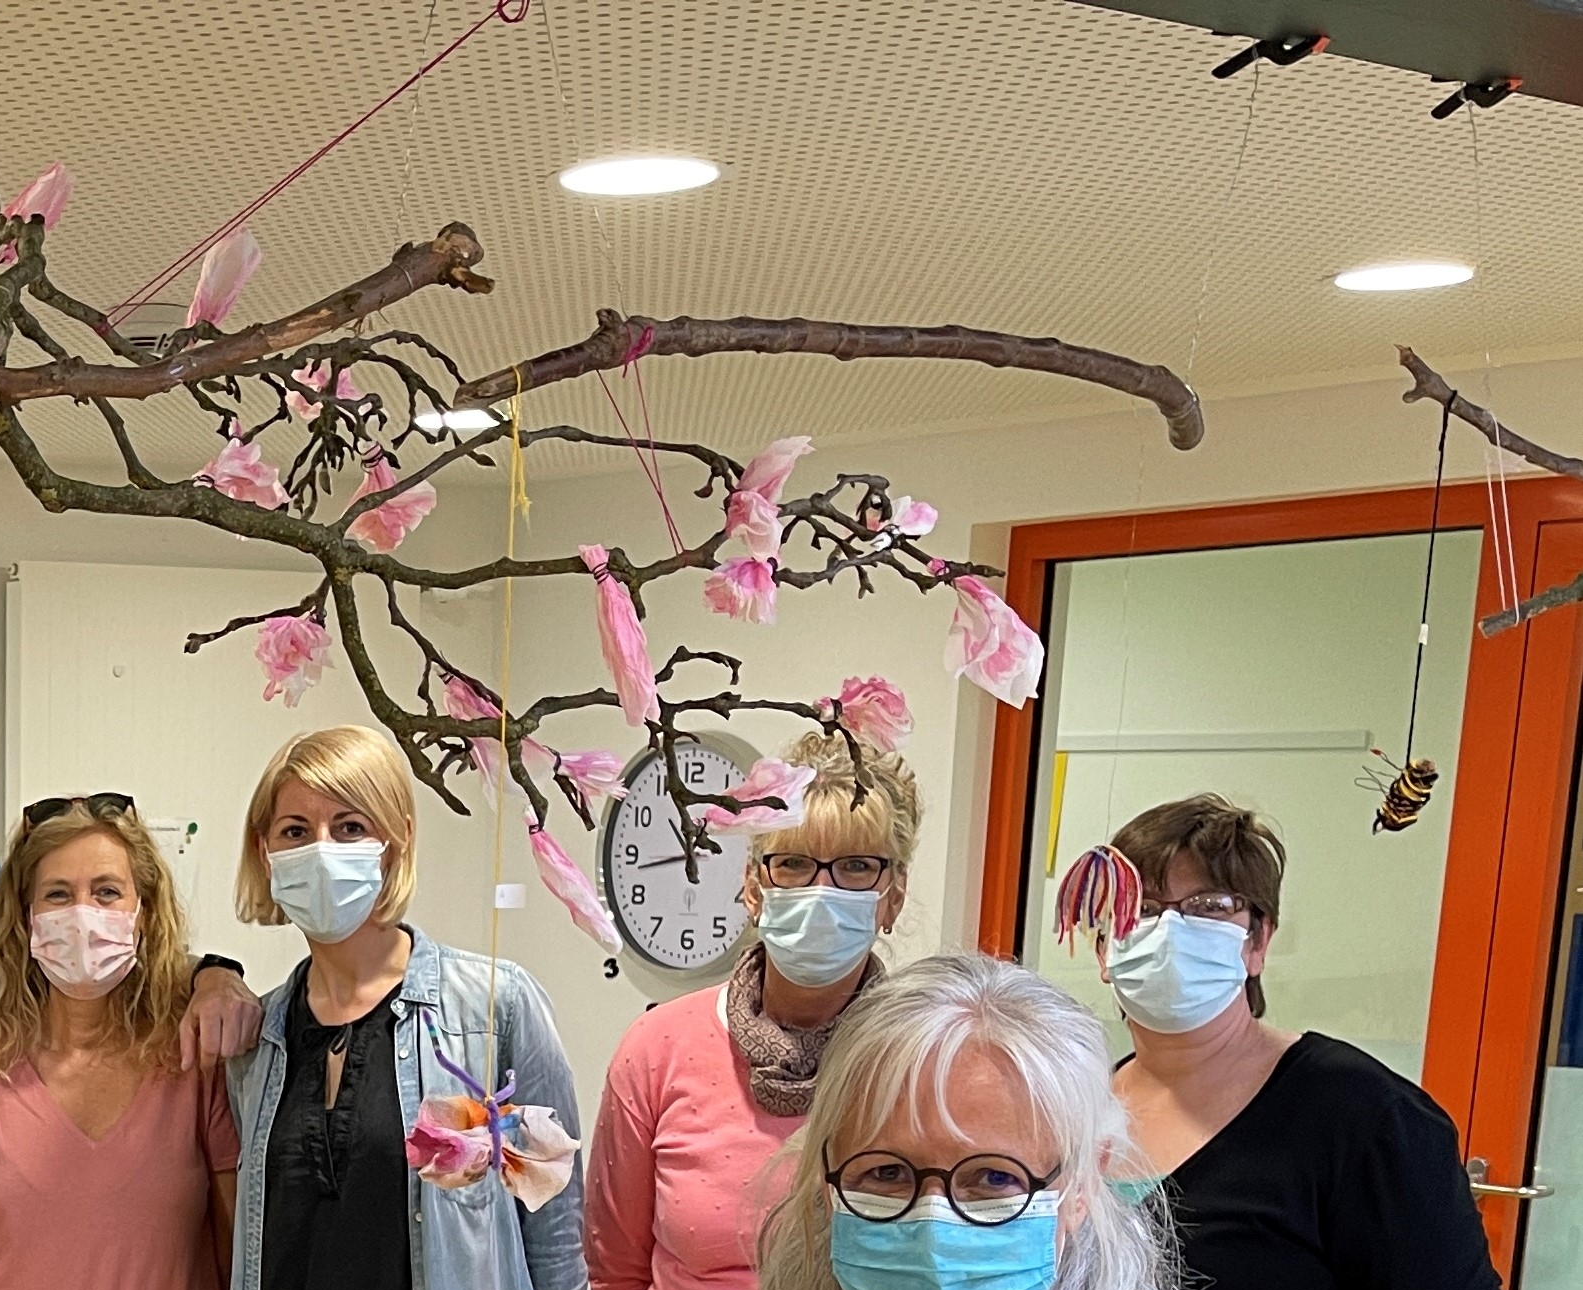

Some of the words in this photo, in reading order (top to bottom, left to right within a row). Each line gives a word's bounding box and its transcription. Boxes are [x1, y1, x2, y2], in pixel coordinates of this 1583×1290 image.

[684, 762, 705, 784] 12
[634, 805, 652, 828] 10
[625, 844, 639, 865] 9
[631, 884, 645, 905] 8
[650, 916, 663, 937] 7
[712, 916, 727, 938] 5
[680, 929, 695, 950] 6
[603, 958, 619, 979] 3
